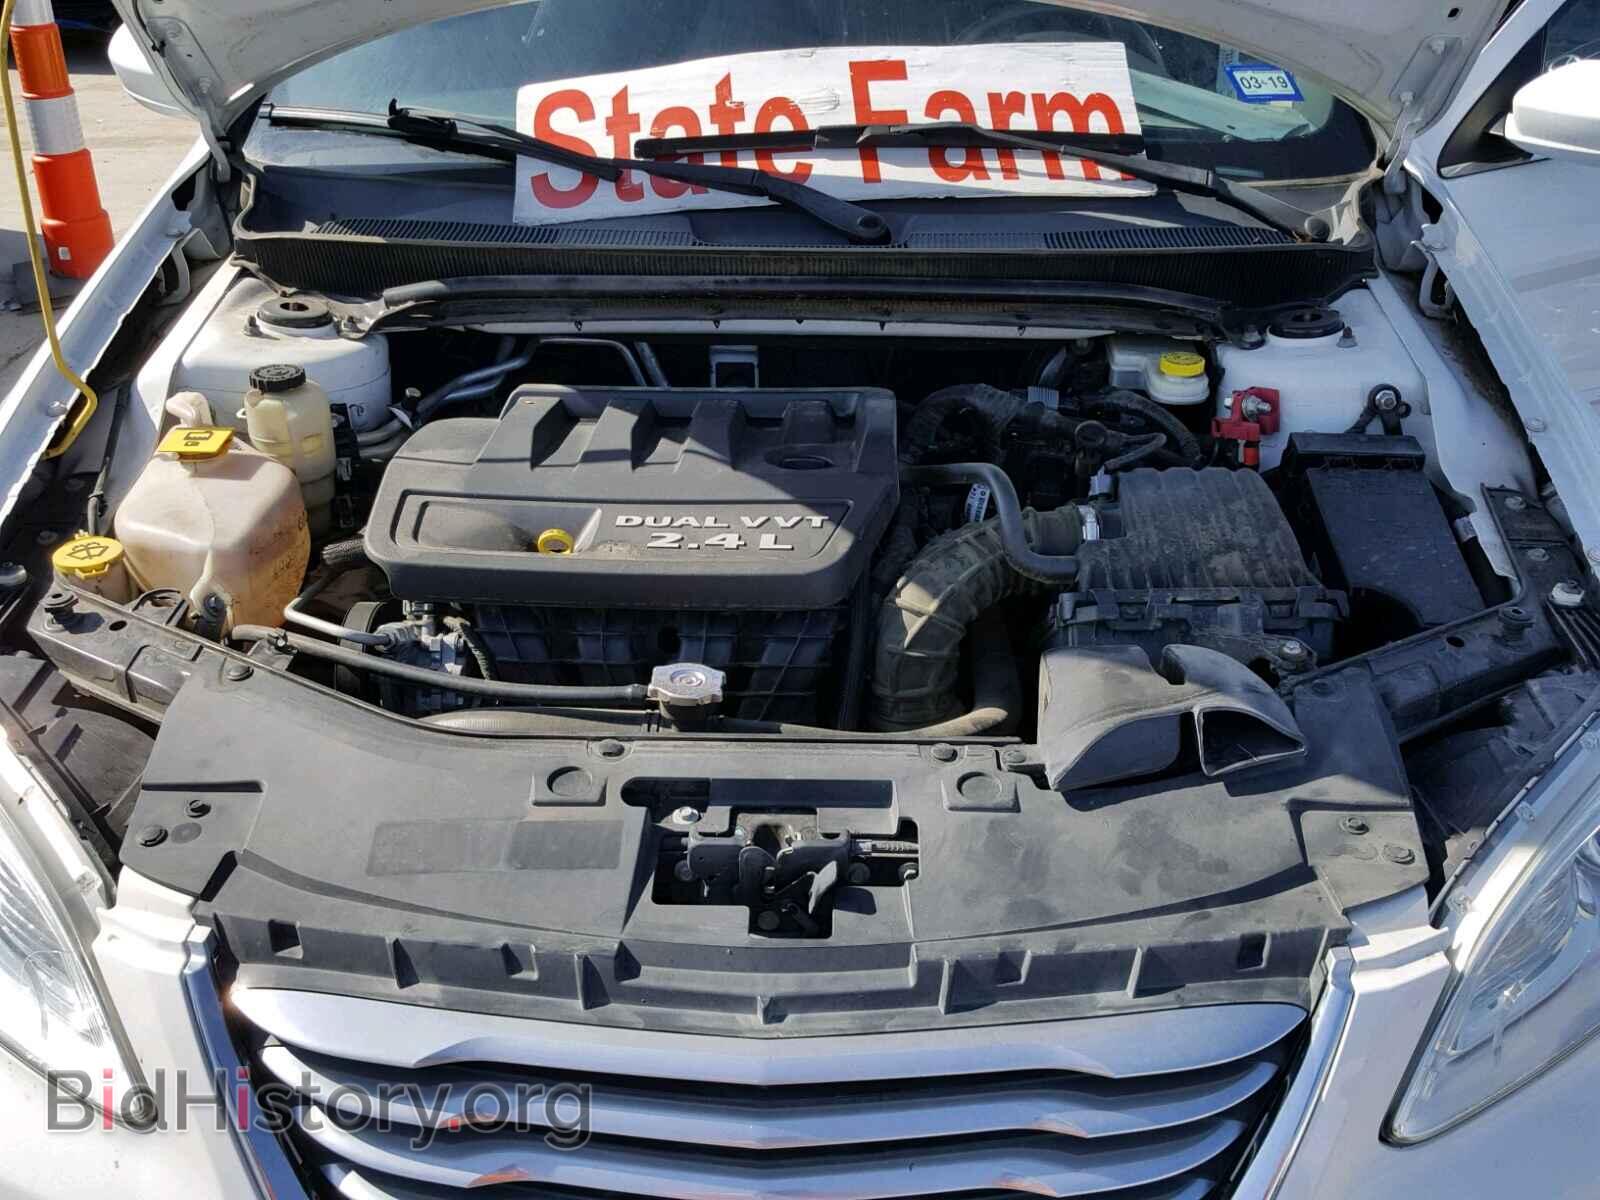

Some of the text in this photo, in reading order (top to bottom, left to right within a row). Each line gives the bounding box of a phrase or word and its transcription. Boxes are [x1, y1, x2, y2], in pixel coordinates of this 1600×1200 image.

[530, 59, 1137, 209] State Farm
[615, 515, 829, 529] DUAL VVT
